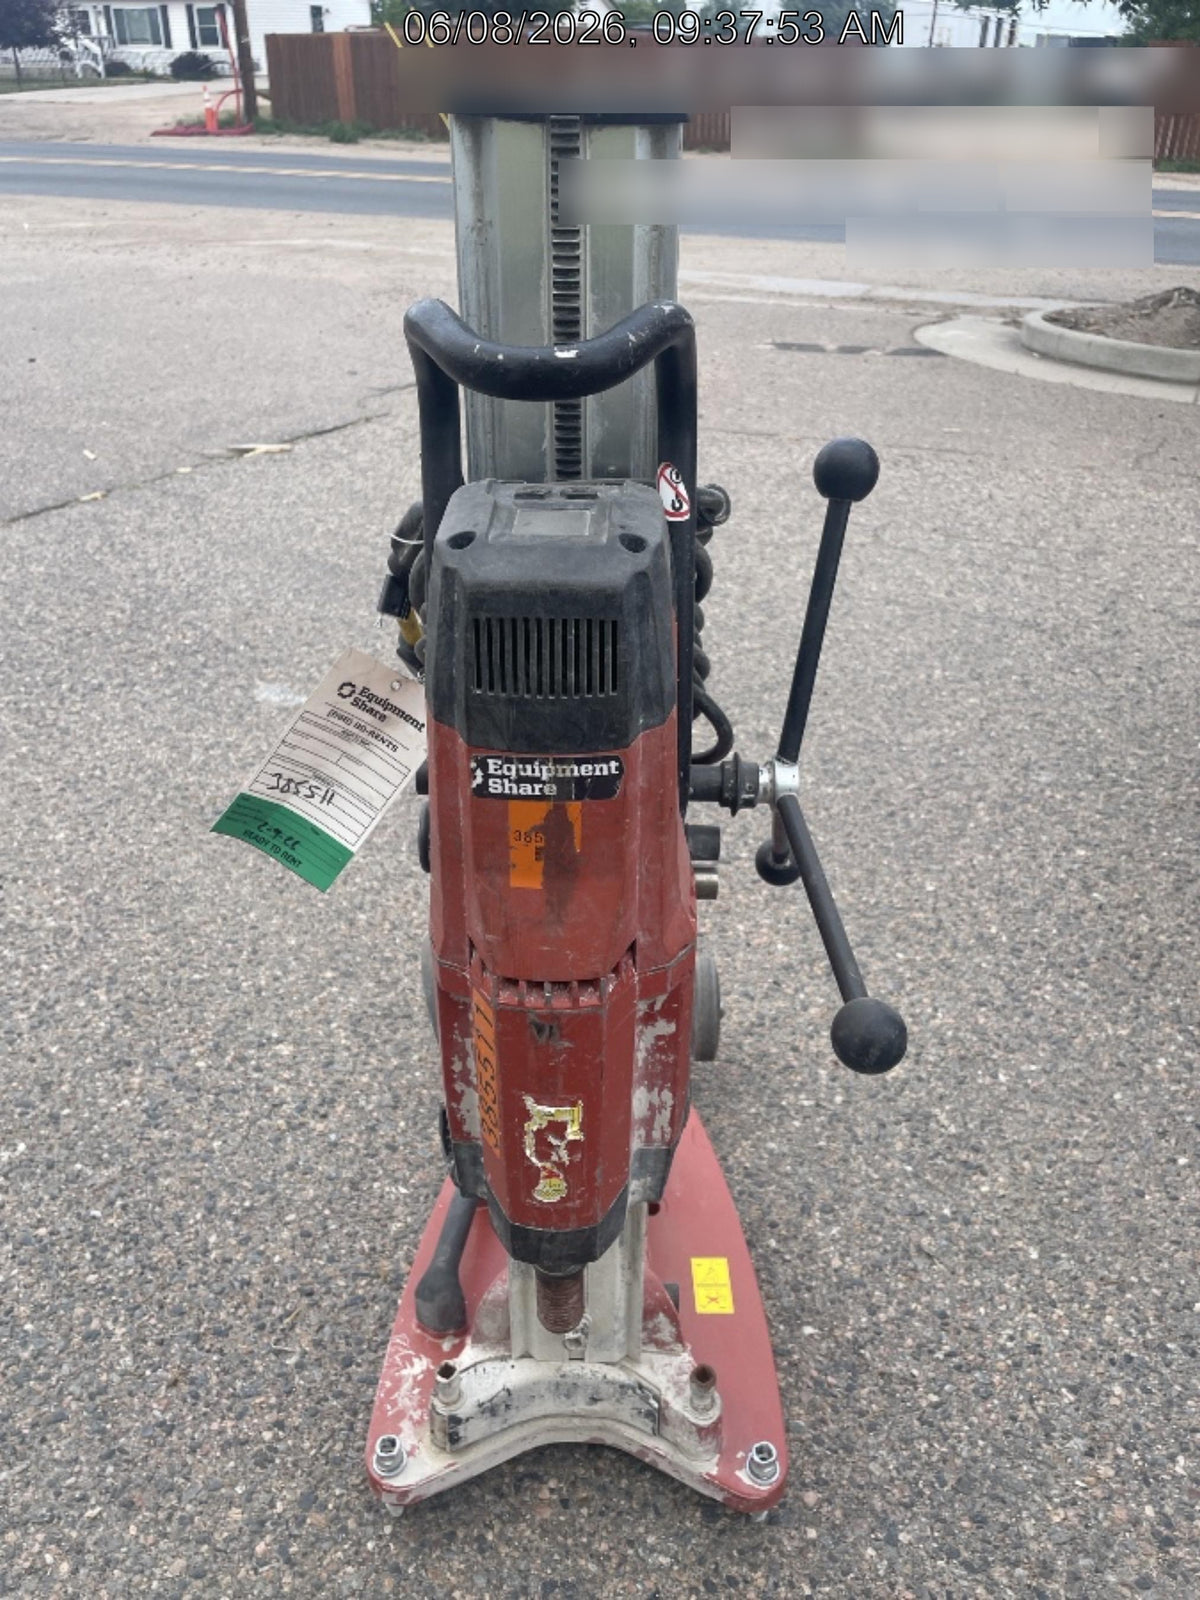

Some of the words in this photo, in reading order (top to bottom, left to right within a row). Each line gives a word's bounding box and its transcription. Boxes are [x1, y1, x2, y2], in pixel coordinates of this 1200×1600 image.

[351, 696, 388, 724] Share
[359, 686, 426, 733] Equipment
[486, 758, 620, 781] Equipment
[487, 778, 557, 796] Share
[269, 842, 283, 856] TO
[281, 850, 304, 869] RENT
